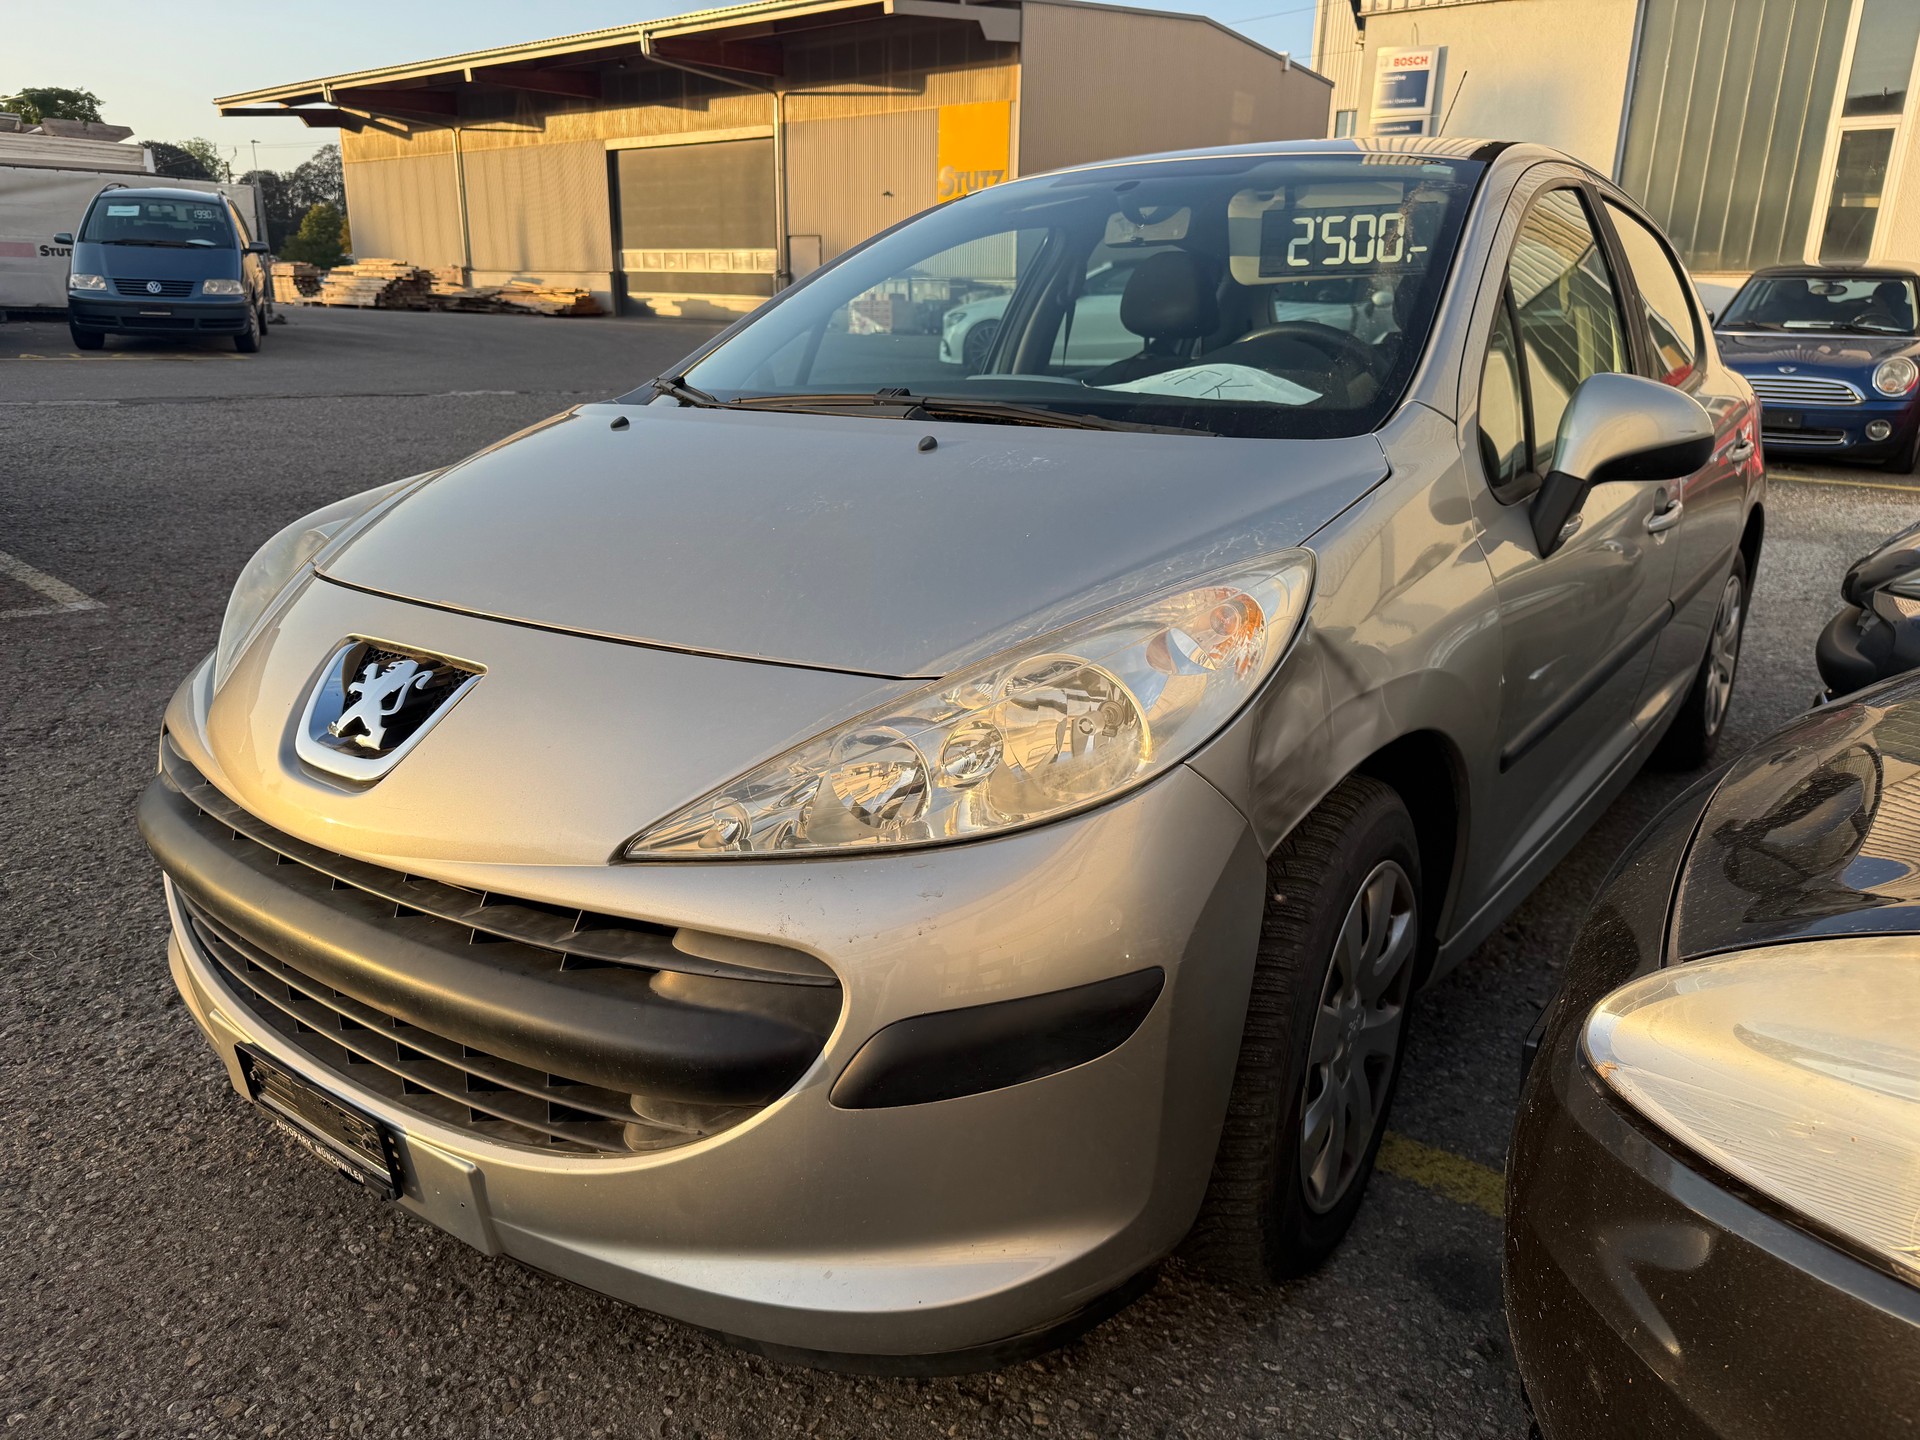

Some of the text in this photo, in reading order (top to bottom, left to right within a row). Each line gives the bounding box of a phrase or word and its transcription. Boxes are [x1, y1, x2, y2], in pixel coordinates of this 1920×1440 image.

[1393, 56, 1429, 67] BOSCH
[39, 244, 73, 257] STUT
[276, 1119, 365, 1184] AUTOPARK MÜNCHWILEN
